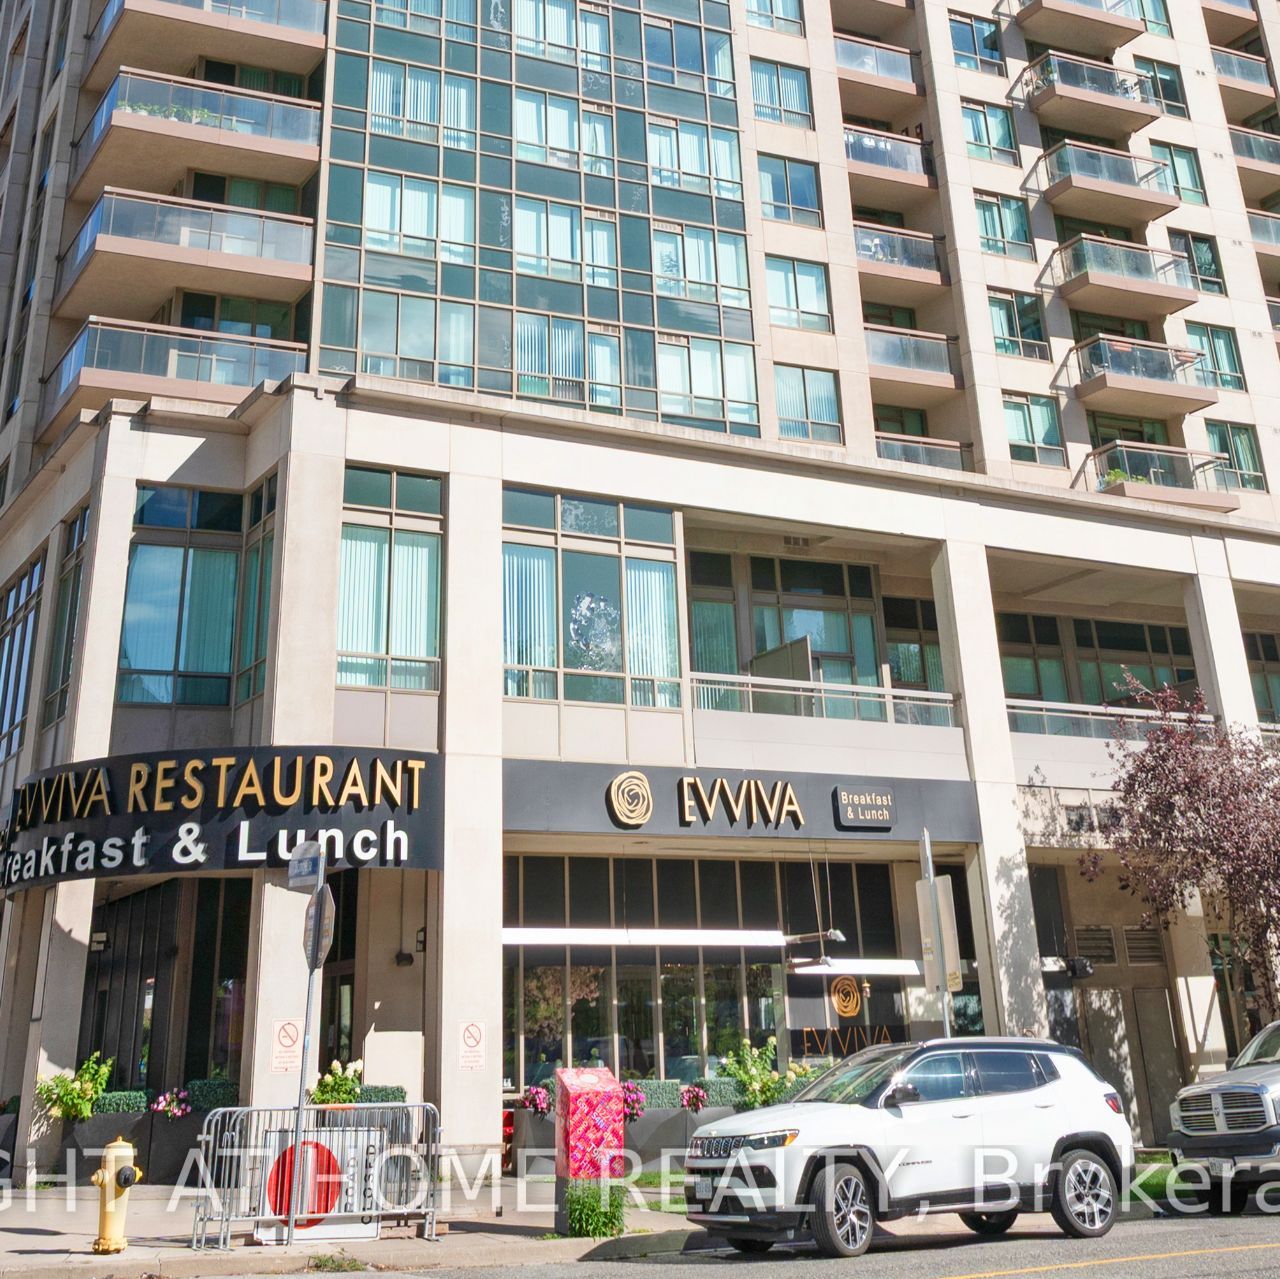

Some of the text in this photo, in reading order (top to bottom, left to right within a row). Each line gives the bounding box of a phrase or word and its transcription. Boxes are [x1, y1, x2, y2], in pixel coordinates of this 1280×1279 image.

[127, 756, 426, 813] RESTAURANT
[682, 776, 806, 826] EVVIVA
[840, 791, 893, 806] Breakfast
[847, 806, 890, 820] & Lunch
[2, 820, 409, 886] reakfast & Lunch
